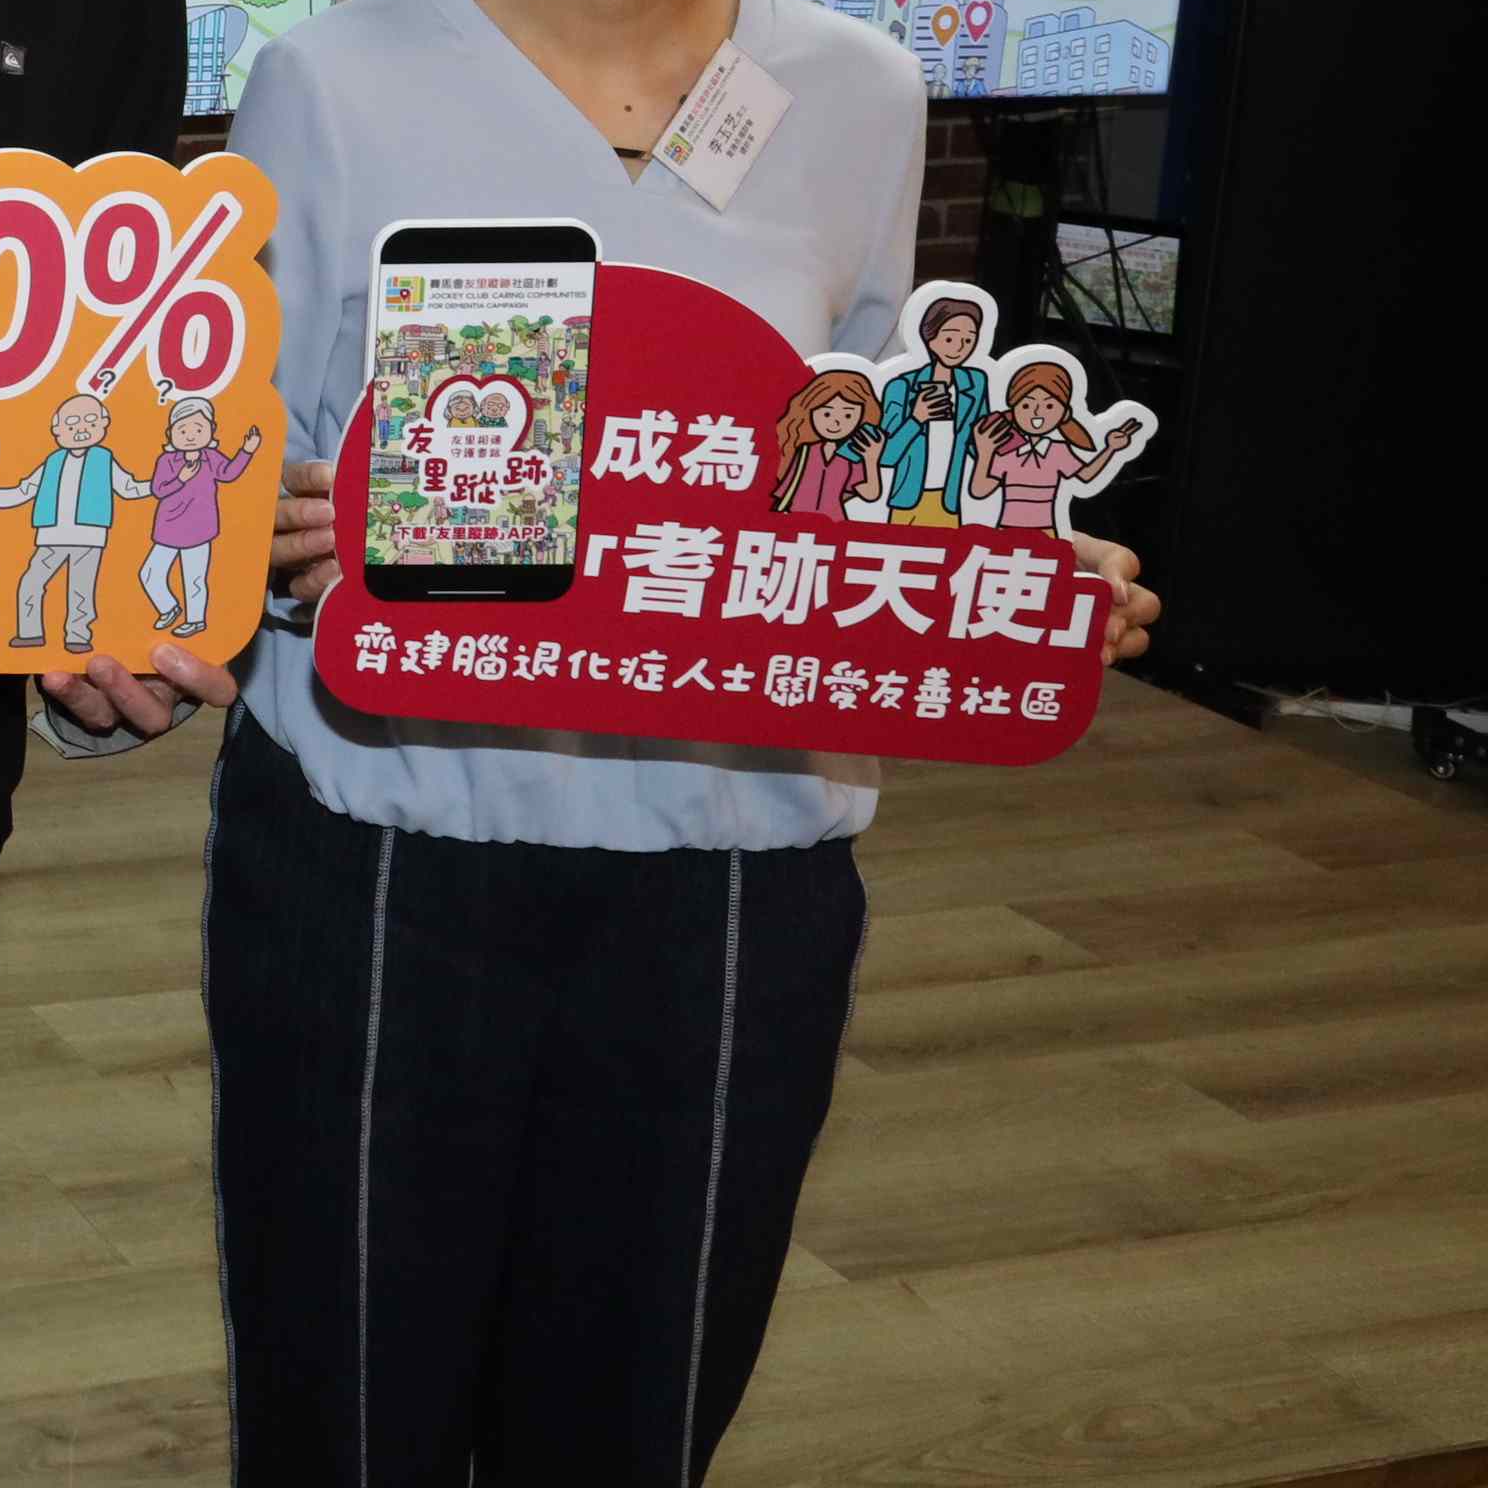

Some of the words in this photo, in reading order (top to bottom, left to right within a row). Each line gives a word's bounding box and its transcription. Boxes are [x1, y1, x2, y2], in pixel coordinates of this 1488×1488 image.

[591, 409, 762, 492] 成為
[584, 522, 1092, 650] 「耆跡天使」
[354, 622, 1067, 722] 齊建腦退化症人士關愛友善社區
